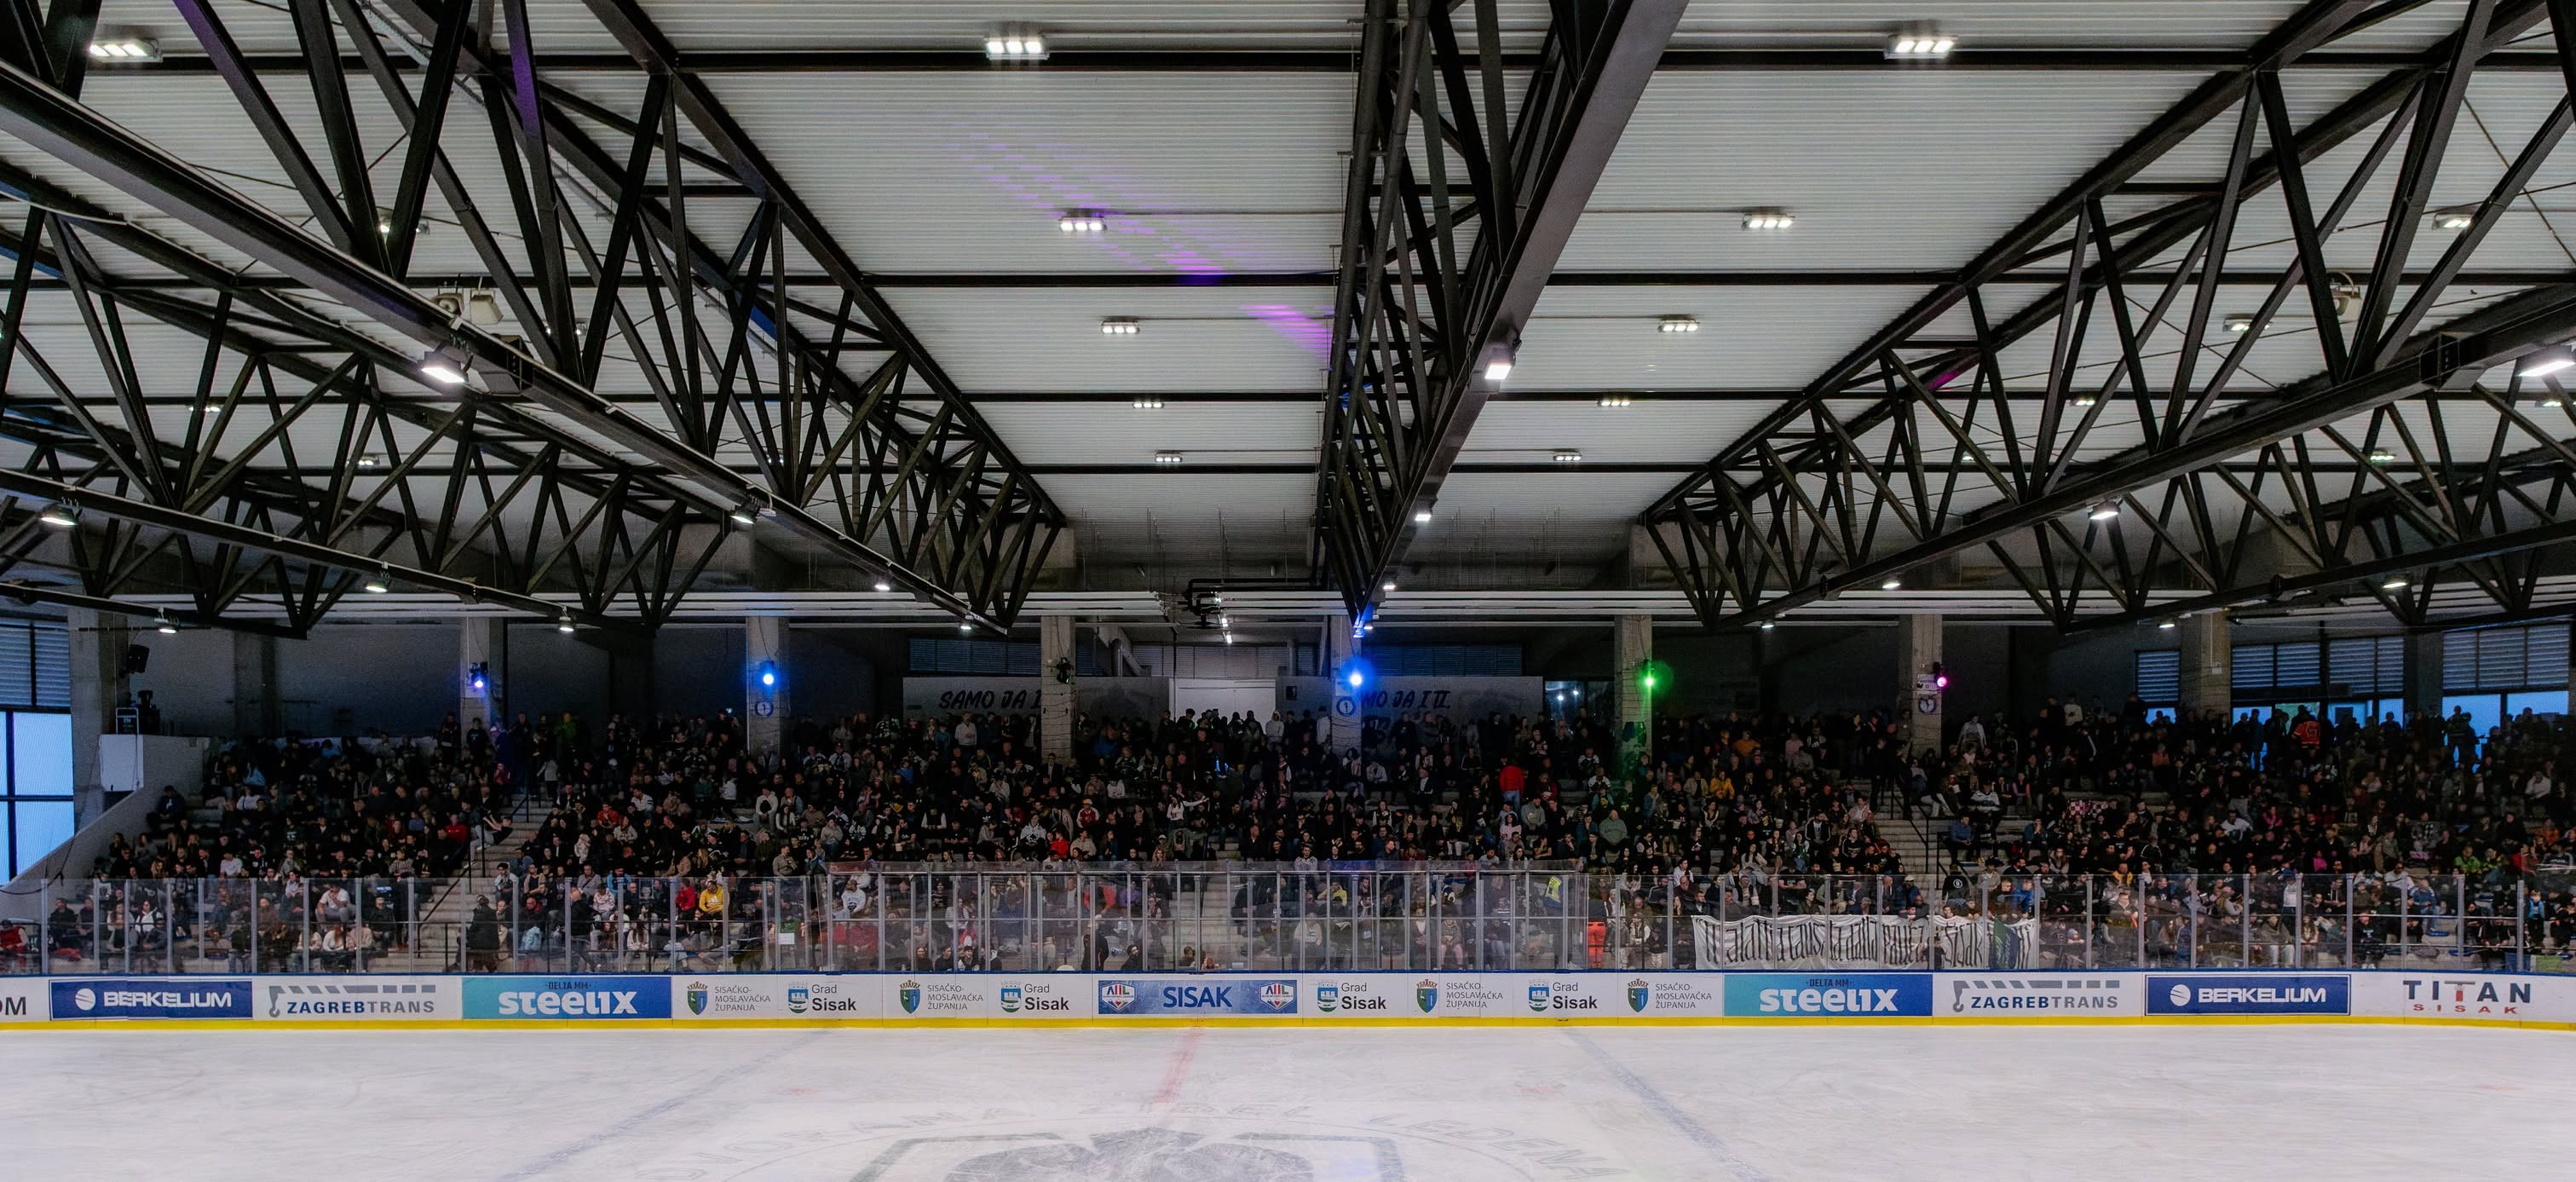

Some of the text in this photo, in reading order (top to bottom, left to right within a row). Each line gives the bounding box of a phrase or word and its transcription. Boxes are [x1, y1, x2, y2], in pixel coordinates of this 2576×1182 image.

[938, 689, 995, 709] SAMO
[1024, 983, 1050, 993] Grad
[1341, 983, 1367, 992] Grad
[1553, 982, 1578, 992] Grad
[1834, 978, 1849, 987] MM
[811, 984, 838, 995] Grad
[1446, 990, 1503, 1000] MOSLAVAČKA
[2403, 980, 2531, 1003] TITAN
[103, 990, 232, 1008] BERKELIUM
[714, 994, 770, 1002] MOSLAVAČKA
[927, 992, 983, 1002] MOSLAVAČKA
[1163, 986, 1232, 1008] SISAK
[1655, 991, 1712, 1000] MOSLAVAČKA
[2198, 988, 2326, 1004] BERKELIUM
[286, 1000, 436, 1014] ZAGREBTRANS
[714, 1002, 756, 1012] ŽUPANIJA
[811, 998, 857, 1012] Sisak
[927, 1001, 968, 1011] ŽUPANIJA
[1024, 996, 1069, 1011] Sisak
[1341, 995, 1386, 1010] Sisak
[1553, 995, 1598, 1009] Sisak
[1655, 1000, 1697, 1009] ŽUPANIJA
[1970, 996, 2118, 1009] ZAGREBTRANS
[2413, 1003, 2518, 1014] SISAK
